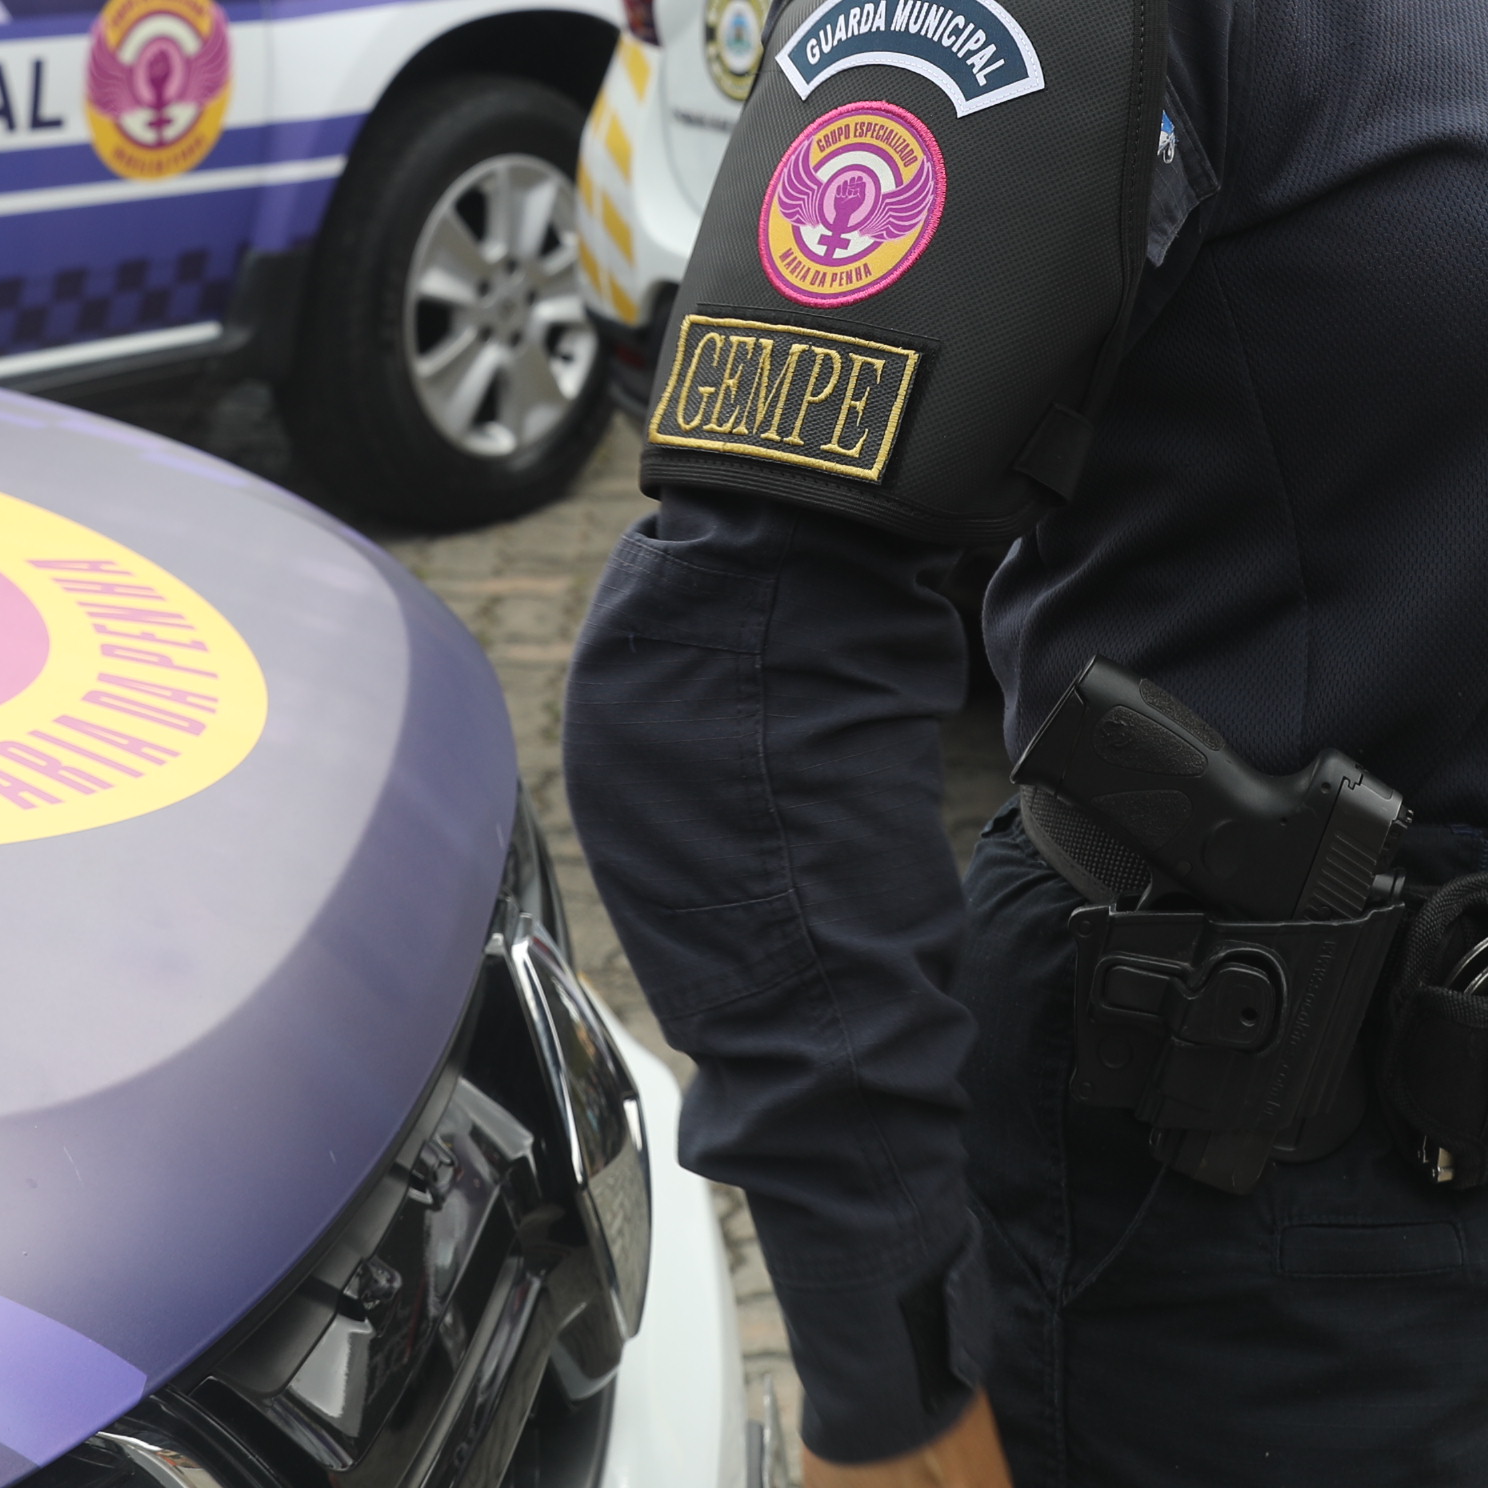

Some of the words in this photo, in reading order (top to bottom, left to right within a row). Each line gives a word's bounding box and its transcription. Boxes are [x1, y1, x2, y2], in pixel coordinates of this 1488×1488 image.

[806, 0, 886, 65] GUARDA
[890, 0, 1005, 87] MUNICIPAL
[816, 124, 850, 153] GRUPO
[853, 121, 918, 168] ESPECIALIZADO
[779, 248, 811, 283] MARIA
[810, 270, 826, 288] DA
[829, 262, 872, 288] PENHA
[676, 331, 887, 459] GEMPE
[24, 559, 220, 681] PENHA
[81, 672, 220, 737] DA
